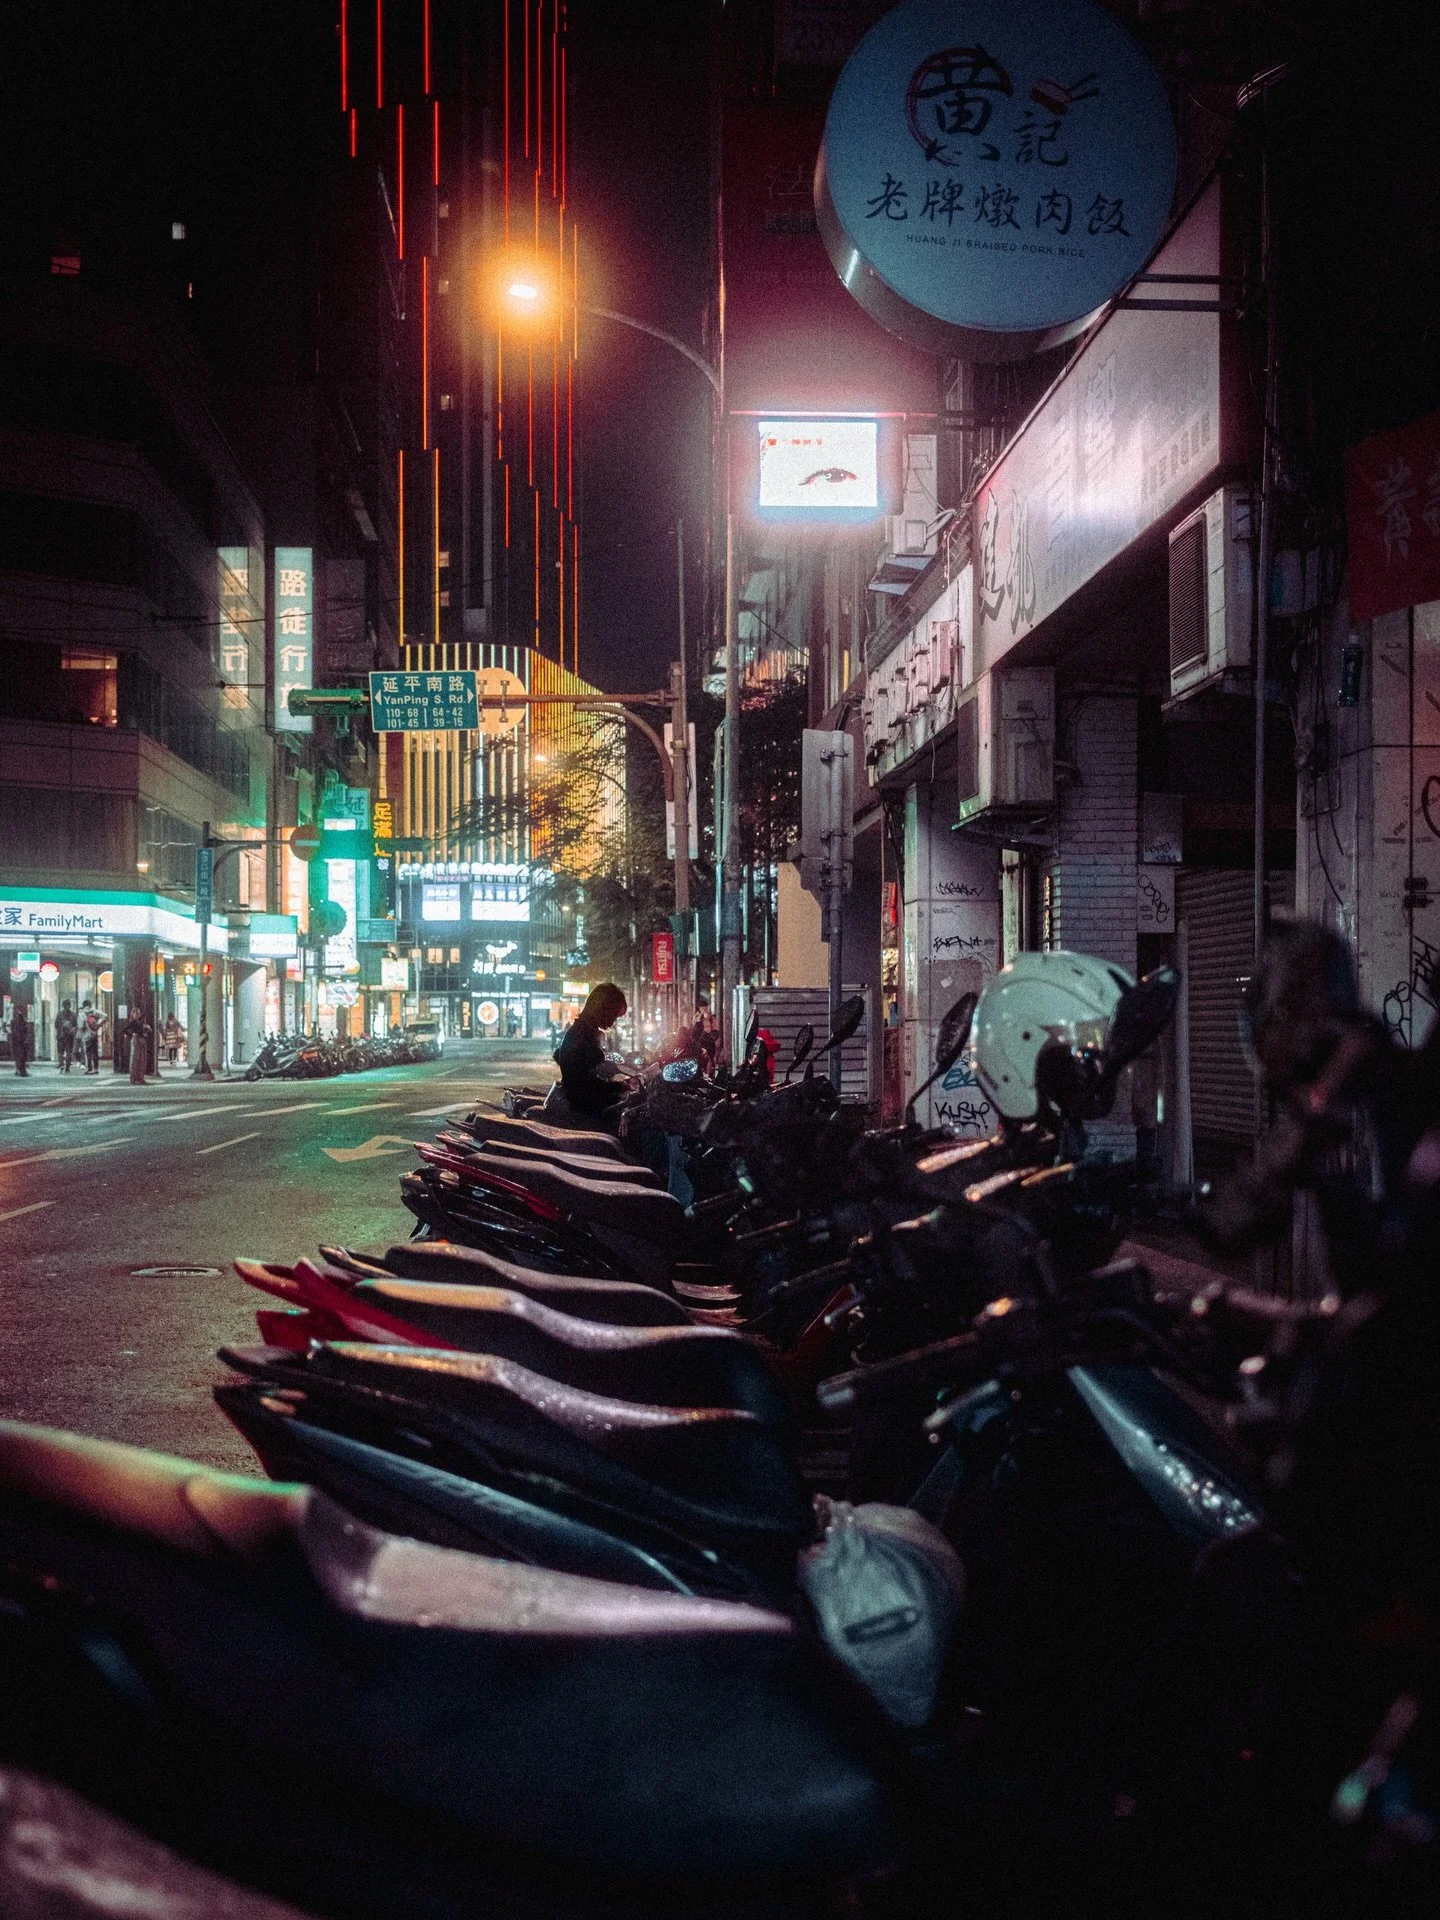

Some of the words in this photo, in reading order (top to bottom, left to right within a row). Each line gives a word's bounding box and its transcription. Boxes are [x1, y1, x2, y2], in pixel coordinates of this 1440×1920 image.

[866, 173, 1131, 239] 老牌燉肉飯
[906, 234, 948, 246] HUANG
[966, 239, 1017, 252] BRAISED
[1022, 244, 1053, 255] PORK
[1057, 247, 1085, 258] RICE
[382, 676, 466, 693] 延平南路
[384, 695, 429, 707] YanPing
[434, 695, 444, 705] S.
[449, 694, 466, 704] Rd.
[386, 708, 419, 719] 110-68
[432, 707, 464, 718] 64-42
[386, 718, 419, 729] 101-45
[433, 718, 464, 728] 39-15
[29, 913, 104, 930] FamilyMart
